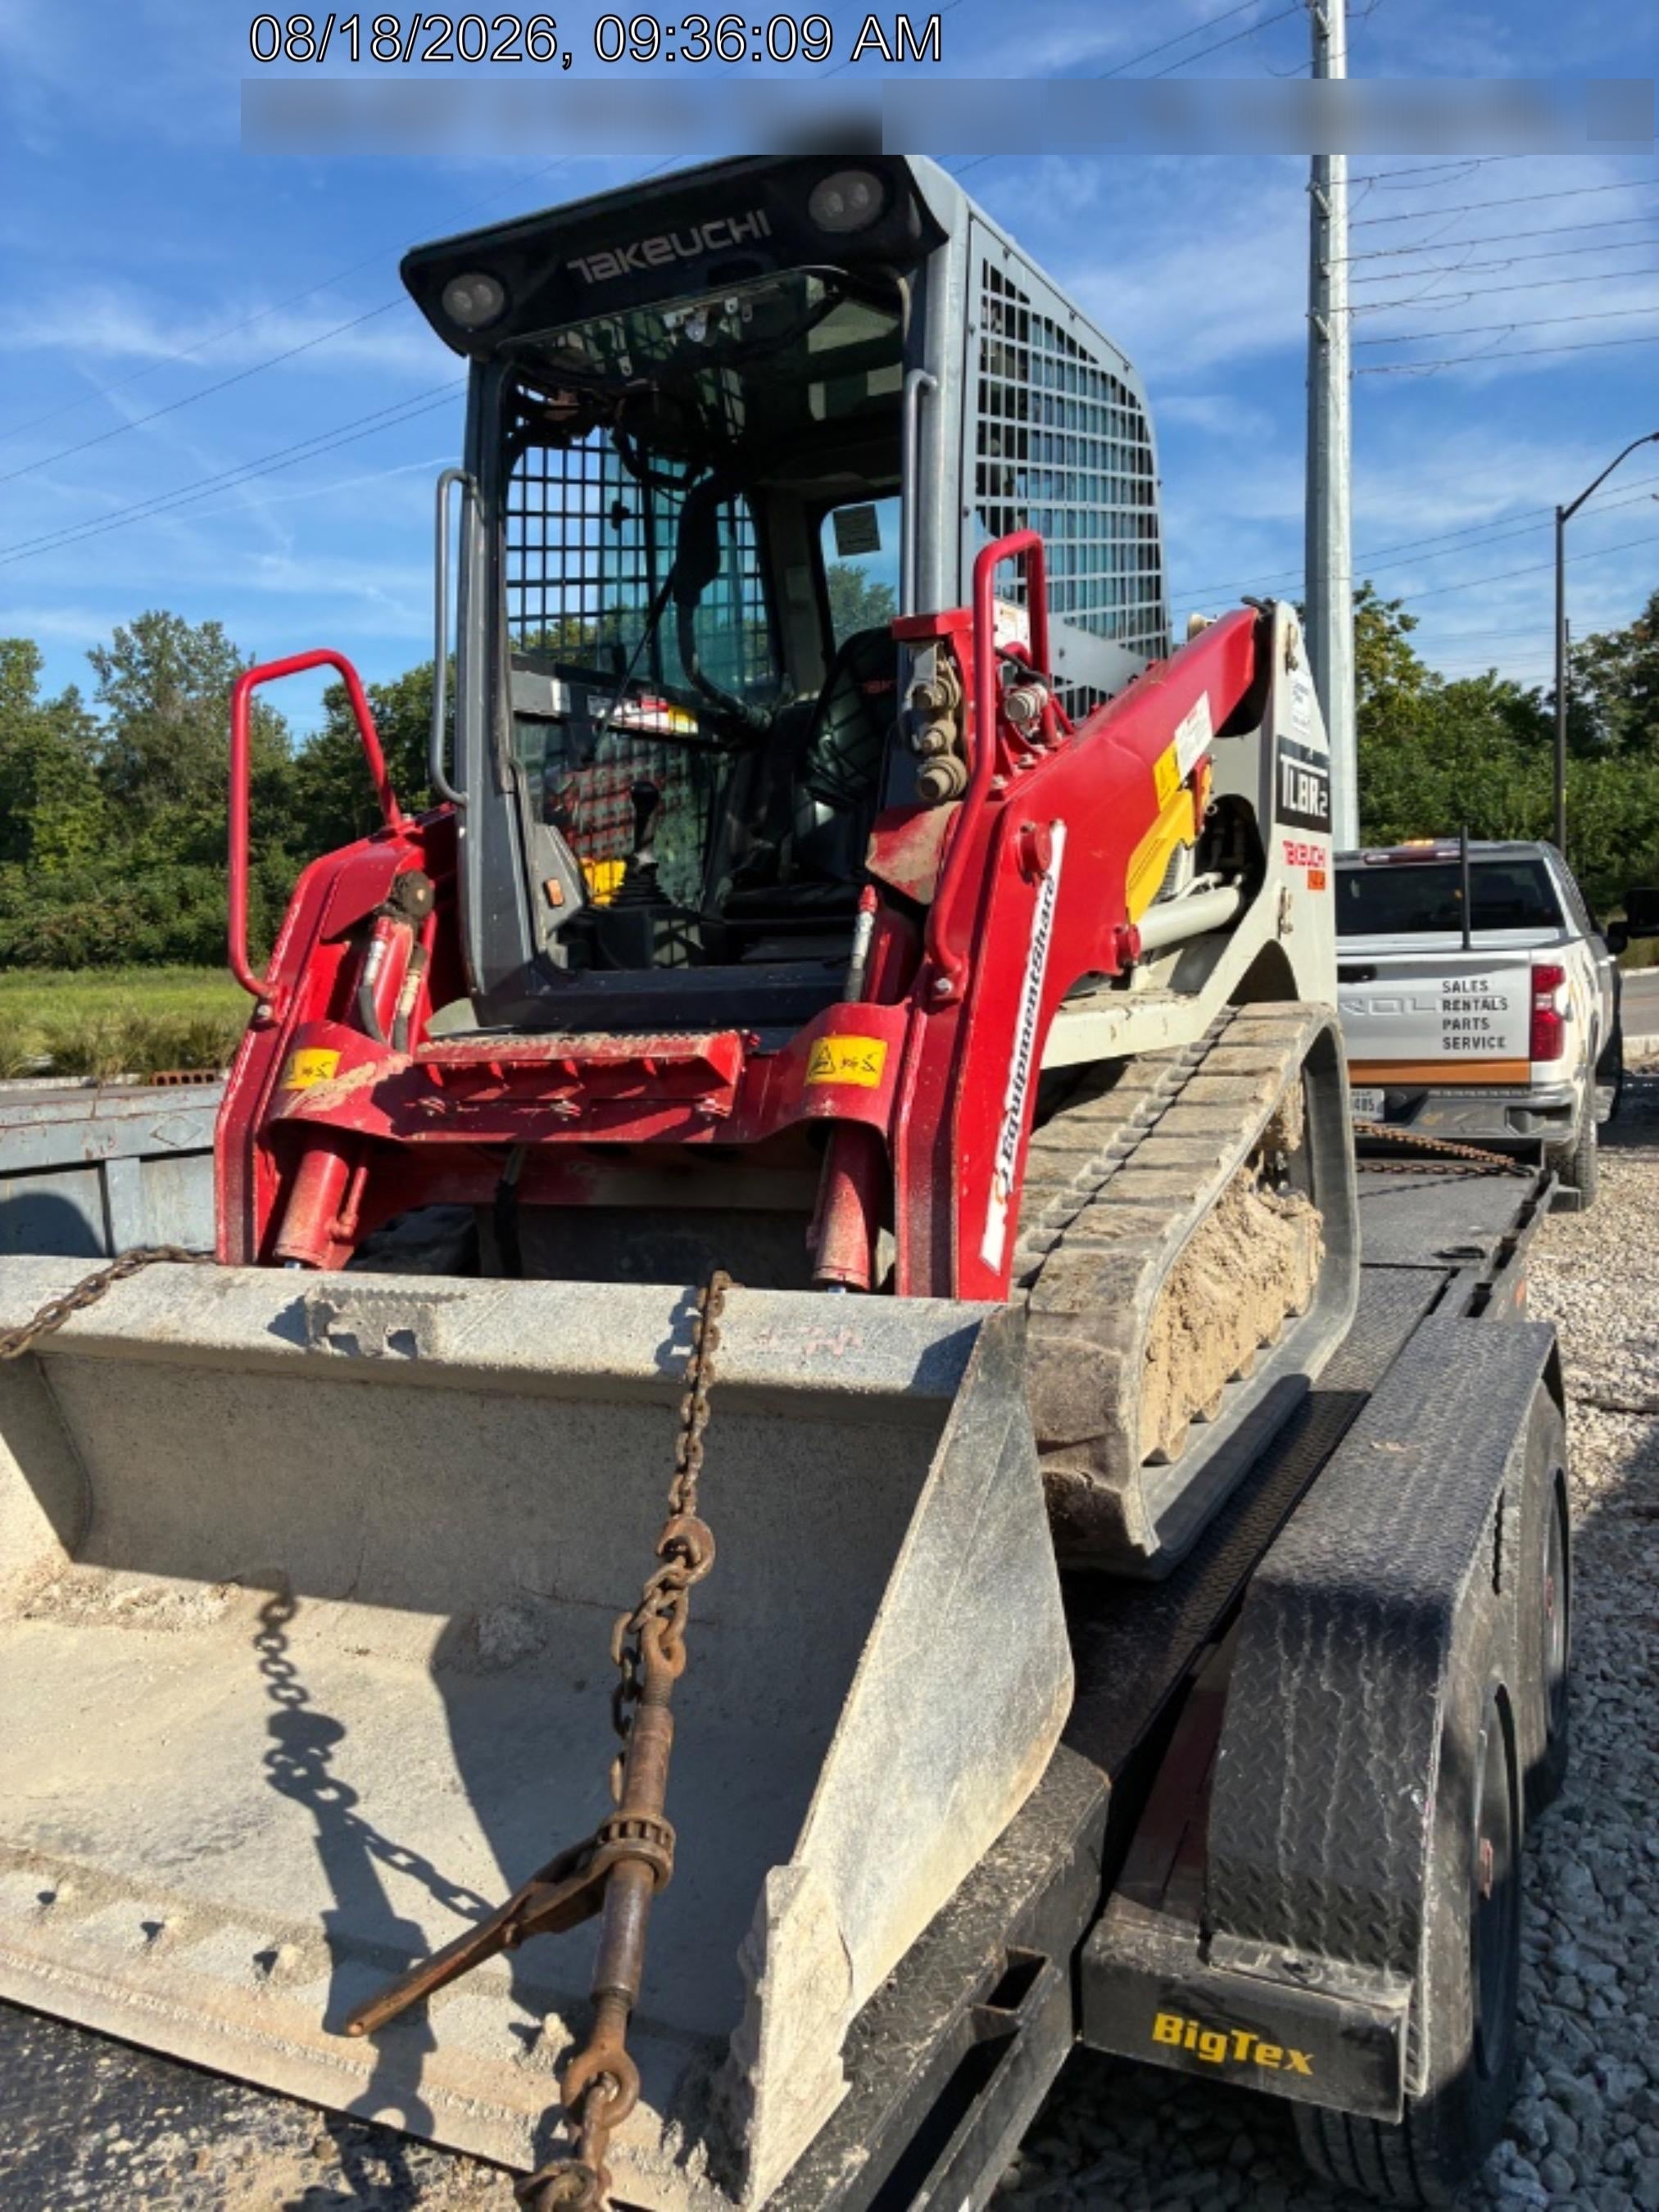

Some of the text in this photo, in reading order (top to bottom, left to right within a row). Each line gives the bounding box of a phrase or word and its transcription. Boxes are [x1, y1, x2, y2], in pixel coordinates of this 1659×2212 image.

[567, 209, 773, 283] TAKEUCHI
[1442, 980, 1489, 994] SALES
[1442, 997, 1508, 1012] RENTALS
[999, 873, 1054, 1162] EquipmentShare
[1442, 1017, 1490, 1031] PARTS
[1442, 1036, 1507, 1050] SERVICE
[1152, 2012, 1315, 2075] BigTex
